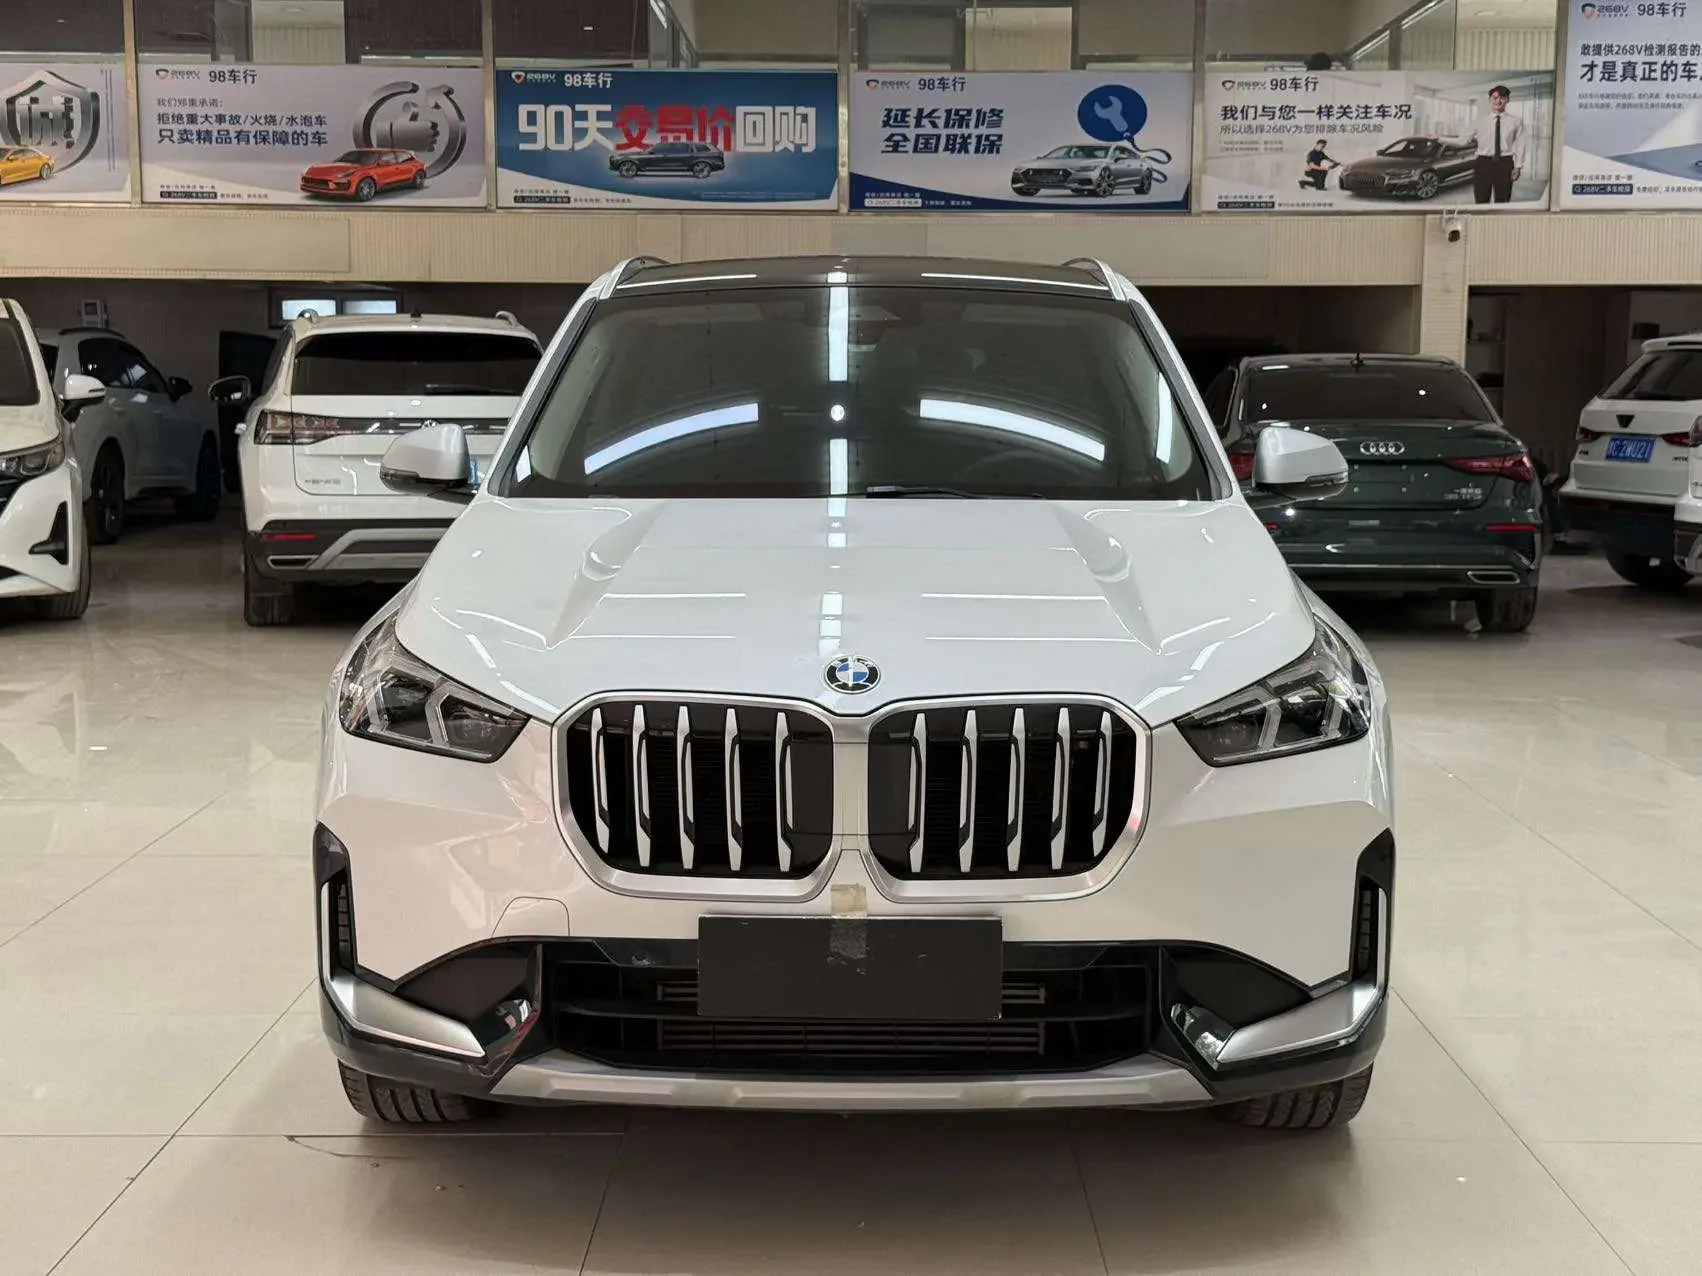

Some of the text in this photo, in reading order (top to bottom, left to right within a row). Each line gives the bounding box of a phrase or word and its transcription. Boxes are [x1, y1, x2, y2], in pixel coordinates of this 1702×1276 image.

[1637, 2, 1686, 17] 98车行
[208, 69, 257, 85] 98车行
[1580, 60, 1702, 82] 才是真正的车
[564, 73, 613, 88] 98车行
[918, 77, 966, 91] 98车行
[1269, 76, 1318, 92] 98车行
[157, 113, 327, 127] 拒绝重大事故/火烧/水泡车
[881, 107, 1004, 129] 延长保修
[1220, 104, 1412, 121] 我们与您一样关注车况
[518, 104, 816, 153] 90天交易价回购
[1219, 123, 1383, 136] 所以选择268V为您排除车况风险
[157, 128, 328, 147] 只卖精品有保障的车
[881, 133, 1003, 154] 全国联保
